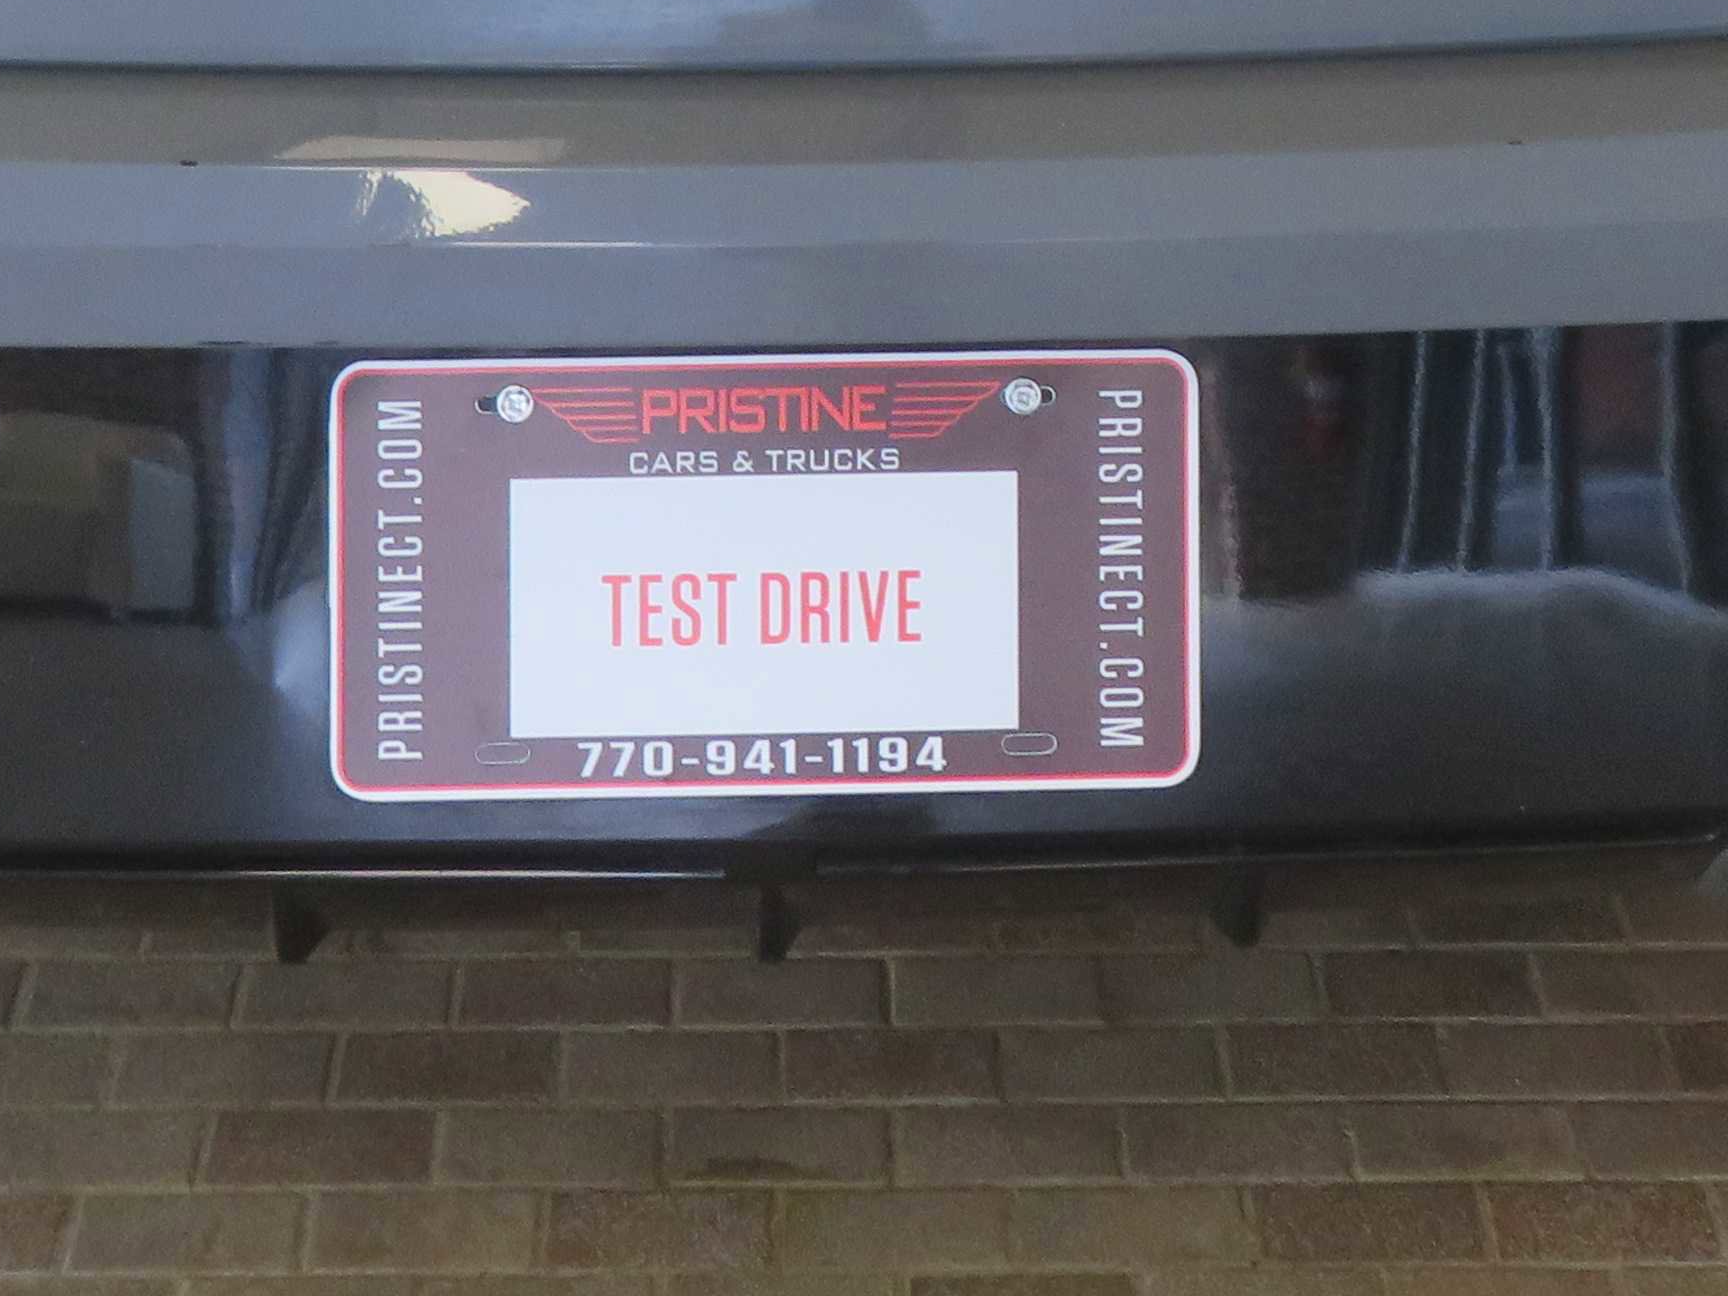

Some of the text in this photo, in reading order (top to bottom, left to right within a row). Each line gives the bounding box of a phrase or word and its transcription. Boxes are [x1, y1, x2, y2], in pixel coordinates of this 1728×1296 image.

[641, 383, 888, 436] PRISTINE
[629, 447, 901, 474] CARS & TRUCKS
[377, 397, 424, 763] PRISTINECT.COM
[1097, 386, 1144, 749] PRISTINECT.COM
[602, 569, 924, 647] TEST DRIVE
[577, 735, 948, 778] 770-941-1194
